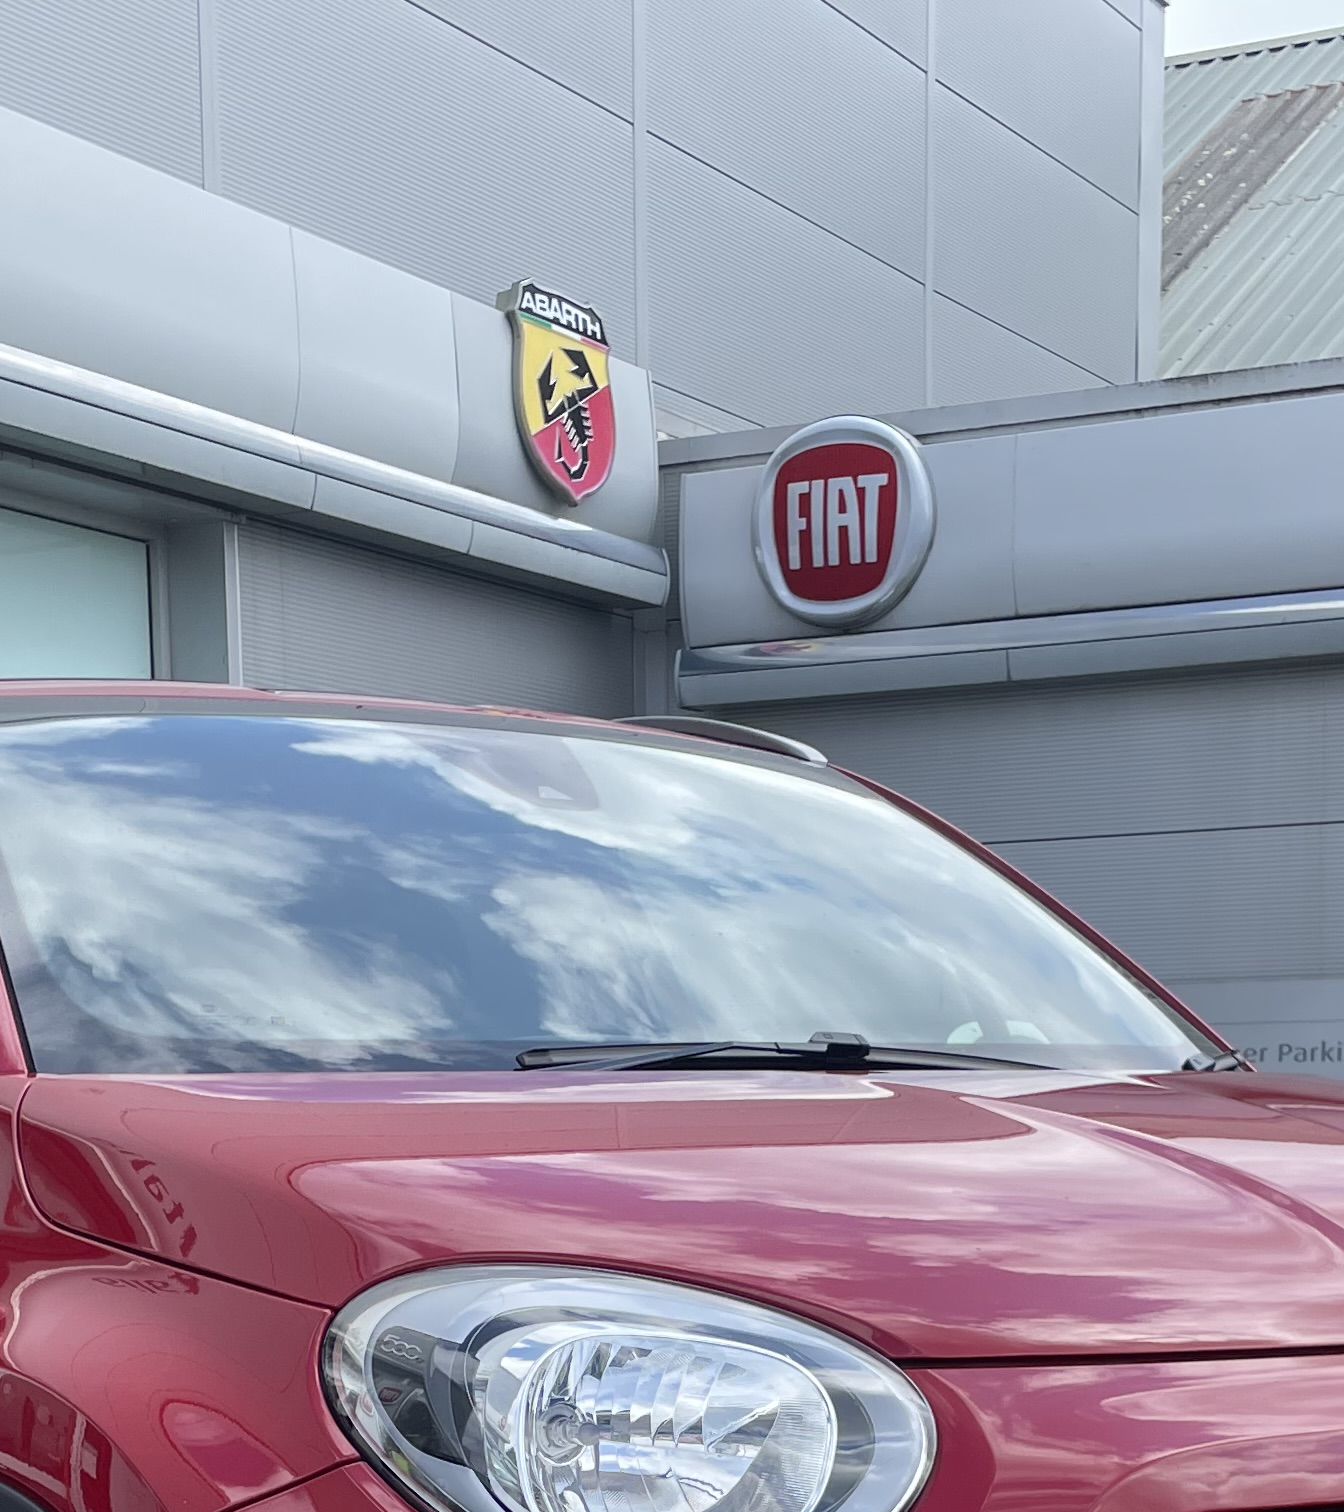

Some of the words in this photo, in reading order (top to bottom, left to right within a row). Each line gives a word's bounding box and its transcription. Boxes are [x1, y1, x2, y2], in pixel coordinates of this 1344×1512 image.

[520, 291, 602, 340] ABARTH
[787, 473, 889, 571] FIAT
[380, 1334, 423, 1360] 500
